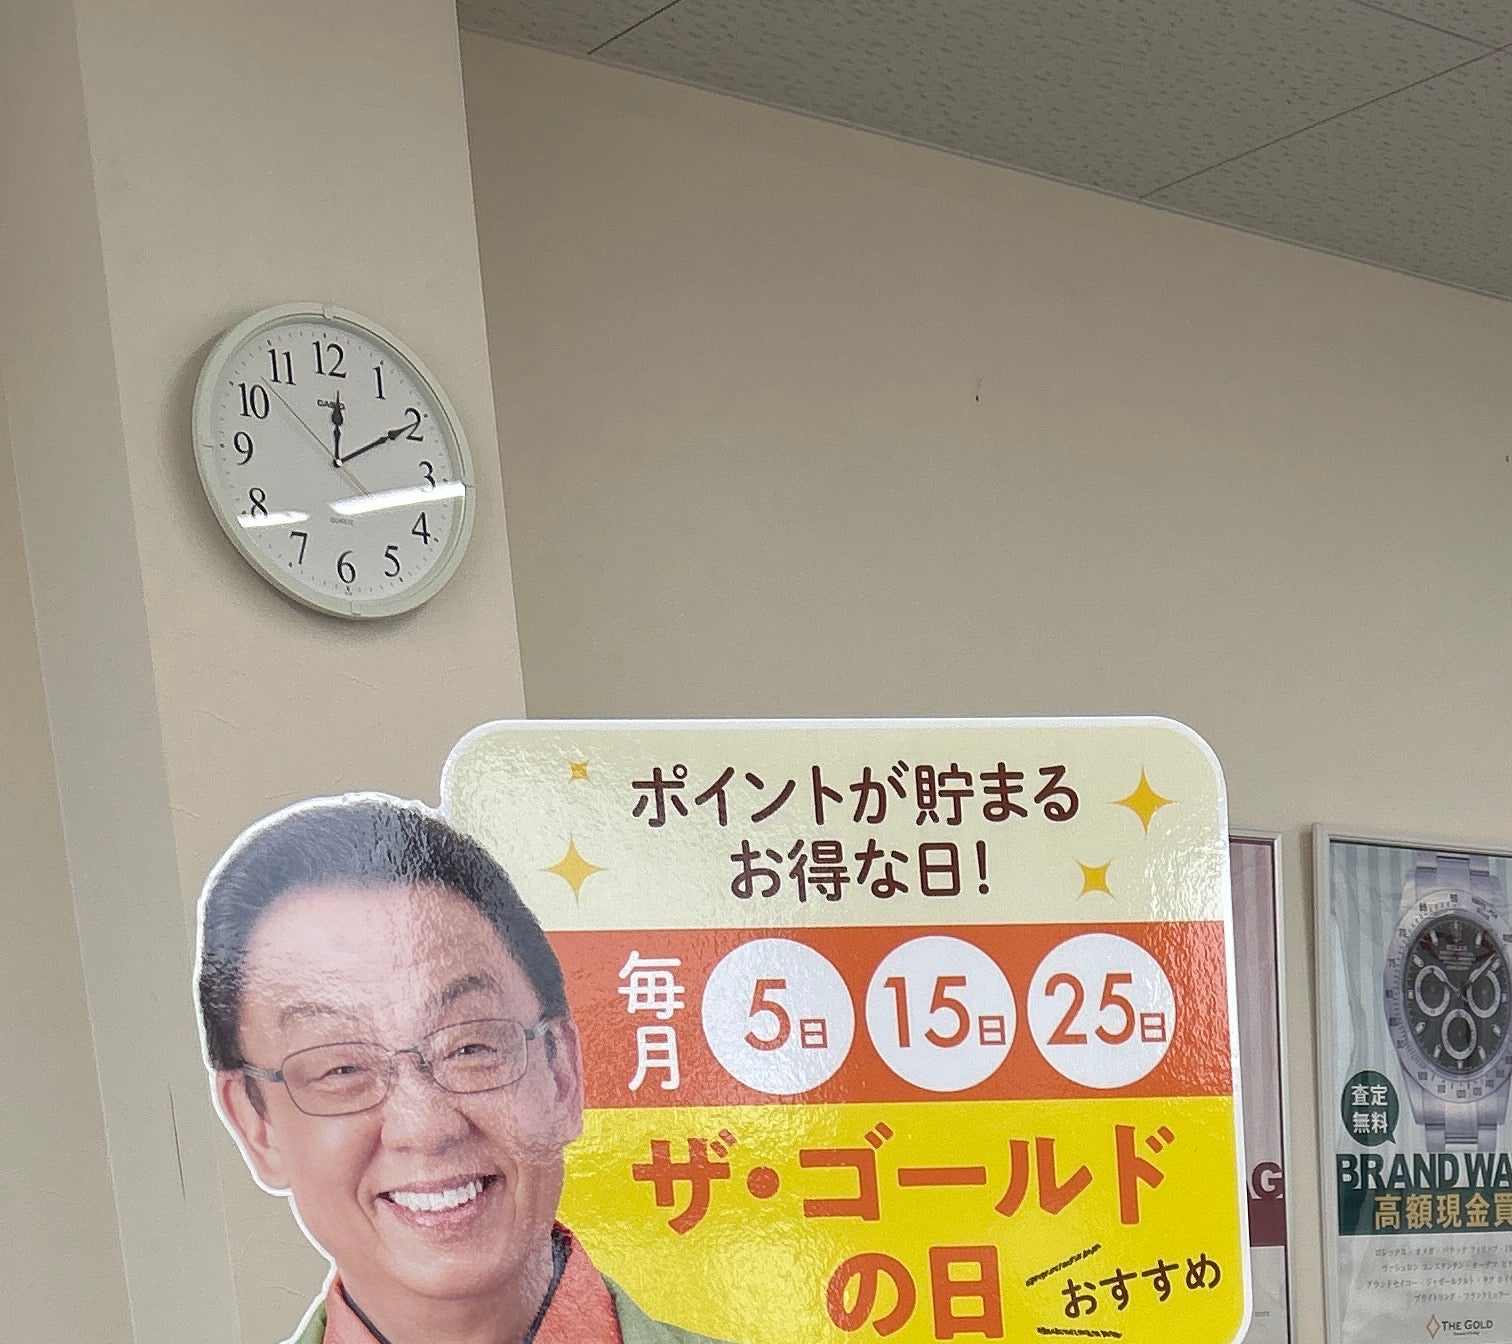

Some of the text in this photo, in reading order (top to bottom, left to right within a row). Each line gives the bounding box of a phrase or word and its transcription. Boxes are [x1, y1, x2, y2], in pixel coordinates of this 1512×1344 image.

[269, 349, 297, 386] 11
[313, 341, 346, 379] 12
[239, 383, 270, 419] 10
[373, 366, 386, 400] 1
[405, 407, 424, 442] 2
[234, 432, 253, 465] 9
[419, 461, 436, 491] 3
[249, 487, 268, 519] 8
[412, 512, 431, 544] 4
[290, 531, 308, 565] 7
[384, 545, 400, 577] 5
[337, 551, 356, 584] 6
[631, 761, 1080, 828] ポイントが貯まる
[729, 838, 991, 902] お得な日!
[617, 950, 686, 1092] 毎月
[745, 979, 829, 1051] 5日
[882, 975, 1006, 1049] 15日
[1044, 971, 1167, 1046] 25日
[1351, 1084, 1388, 1107] 査定
[1352, 1111, 1388, 1134] 無料
[632, 1122, 1177, 1236] ザ・ゴールド
[1336, 1153, 1460, 1190] BRAND
[826, 1244, 1004, 1341] の日
[1061, 1251, 1223, 1319] おすすめ
[1441, 1318, 1493, 1331] THE GOLD
